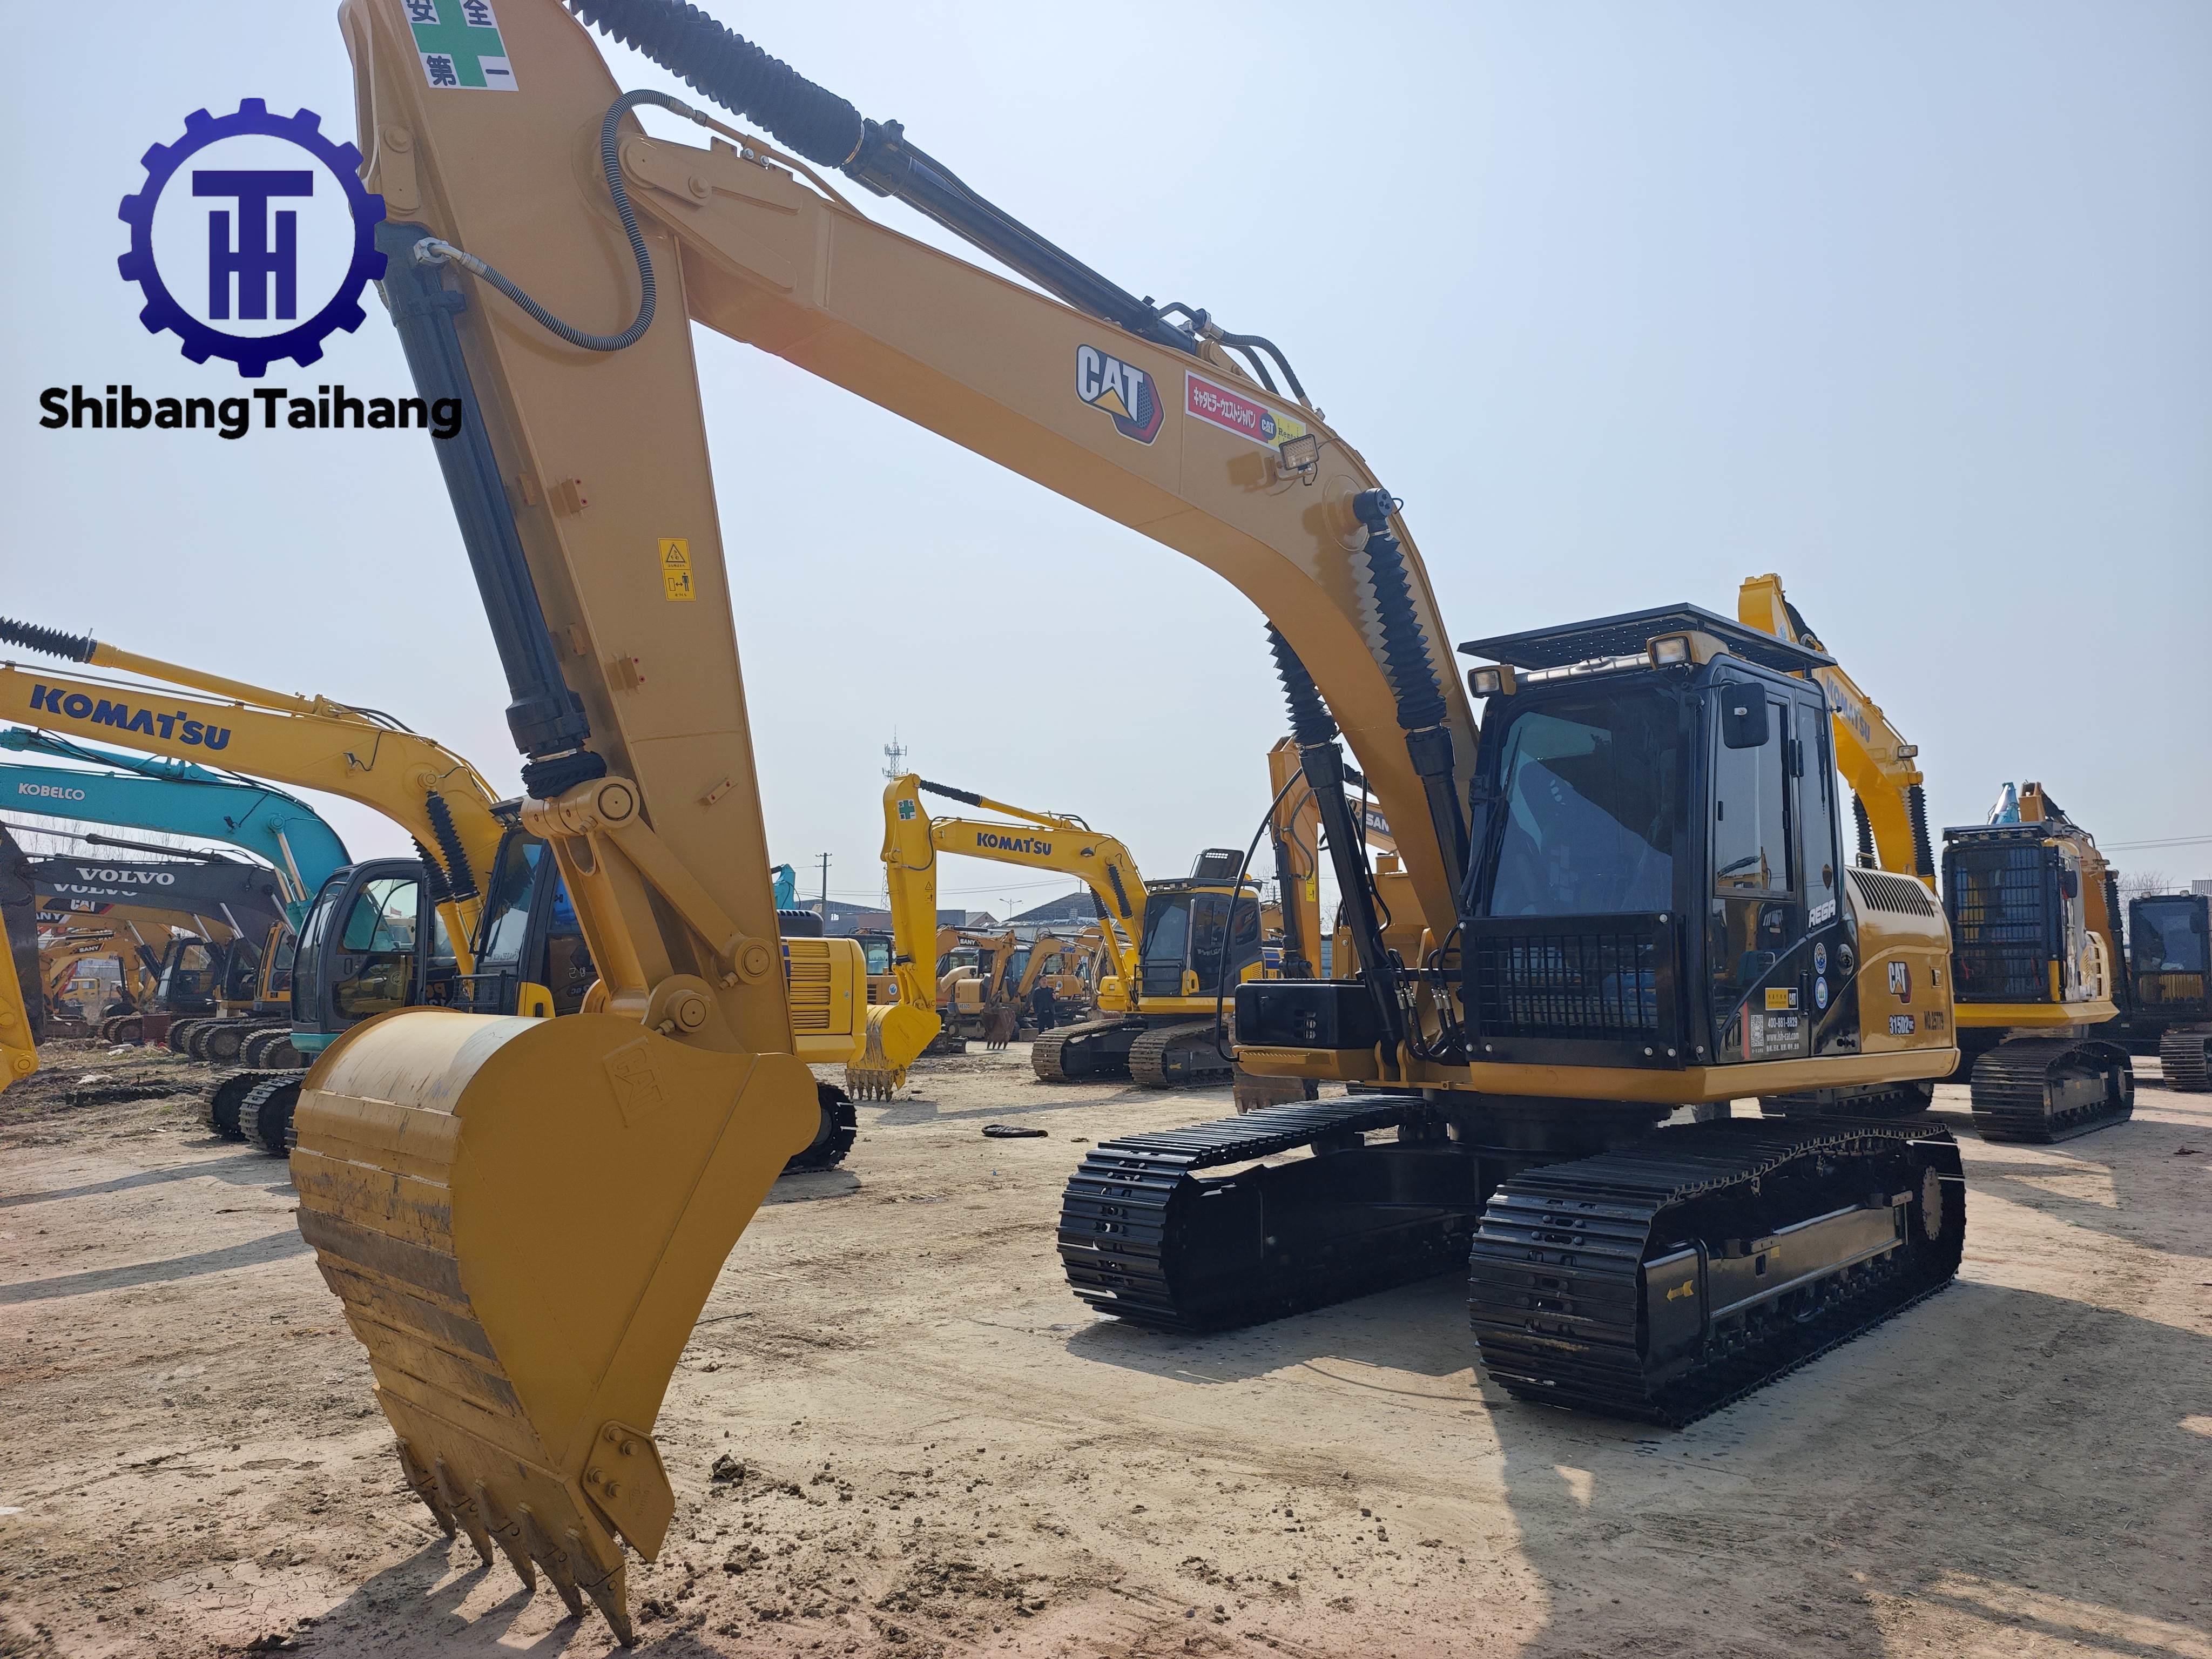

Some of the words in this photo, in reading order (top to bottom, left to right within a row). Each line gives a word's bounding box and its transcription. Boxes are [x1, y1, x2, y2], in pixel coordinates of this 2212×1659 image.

[1077, 345, 1143, 422] CAT
[1261, 419, 1274, 434] CAT
[30, 684, 231, 750] KOMATSU
[1826, 675, 1870, 743] KOMATSU
[18, 783, 85, 800] KOBELCO
[1366, 813, 1390, 832] SAN
[977, 832, 1051, 855] KOMATSU
[76, 867, 175, 885] VOLVO
[36, 912, 64, 920] ANY
[1888, 962, 1906, 994] CAT
